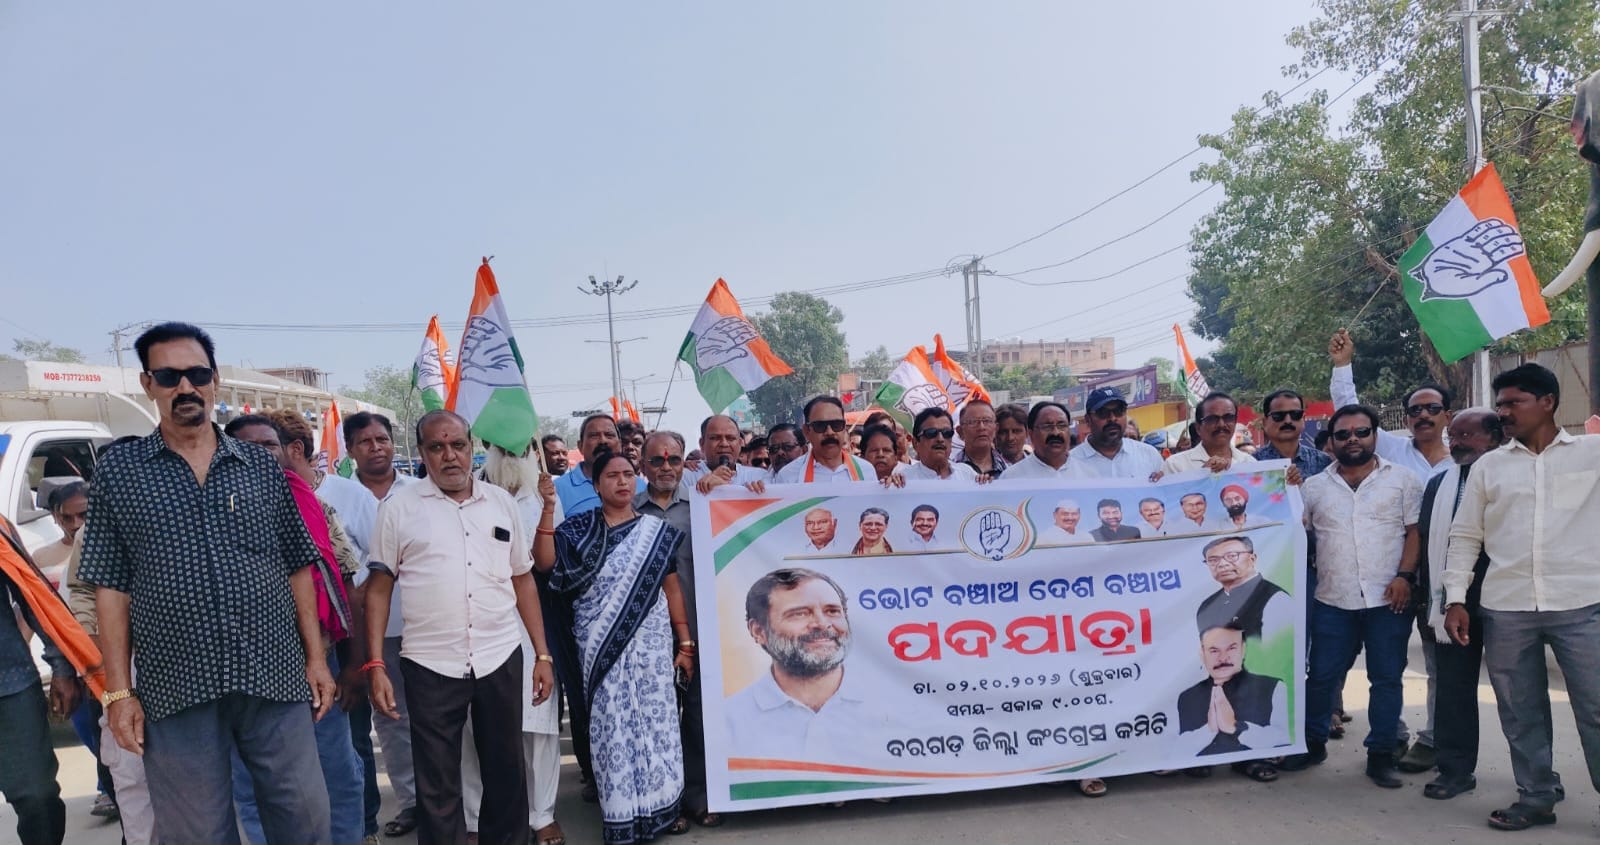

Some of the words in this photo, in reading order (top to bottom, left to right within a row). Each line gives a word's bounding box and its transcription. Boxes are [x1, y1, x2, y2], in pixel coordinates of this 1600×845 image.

[858, 586, 933, 610] ଭୋଟ
[943, 581, 1019, 606] ବଞ୍ଚାଅ
[1028, 575, 1095, 600] ଦେଶ
[1103, 569, 1182, 595] ବଞ୍ଚାଅ
[887, 608, 1153, 662] ପଦଯାତ୍ରା
[913, 683, 937, 694] ତା.
[945, 673, 1061, 692] ୦୨.୧୦.୨୦୨୬
[1069, 663, 1141, 687] (ଶୁକ୍ରବାର)
[1001, 699, 1043, 713] ସକାଳ
[886, 735, 964, 757] ବରଗଡ଼
[972, 727, 1018, 756] ଜିଲ୍ଲା
[1026, 724, 1107, 746] କଂଗ୍ରେସ
[1115, 712, 1168, 739] କମିଟି
